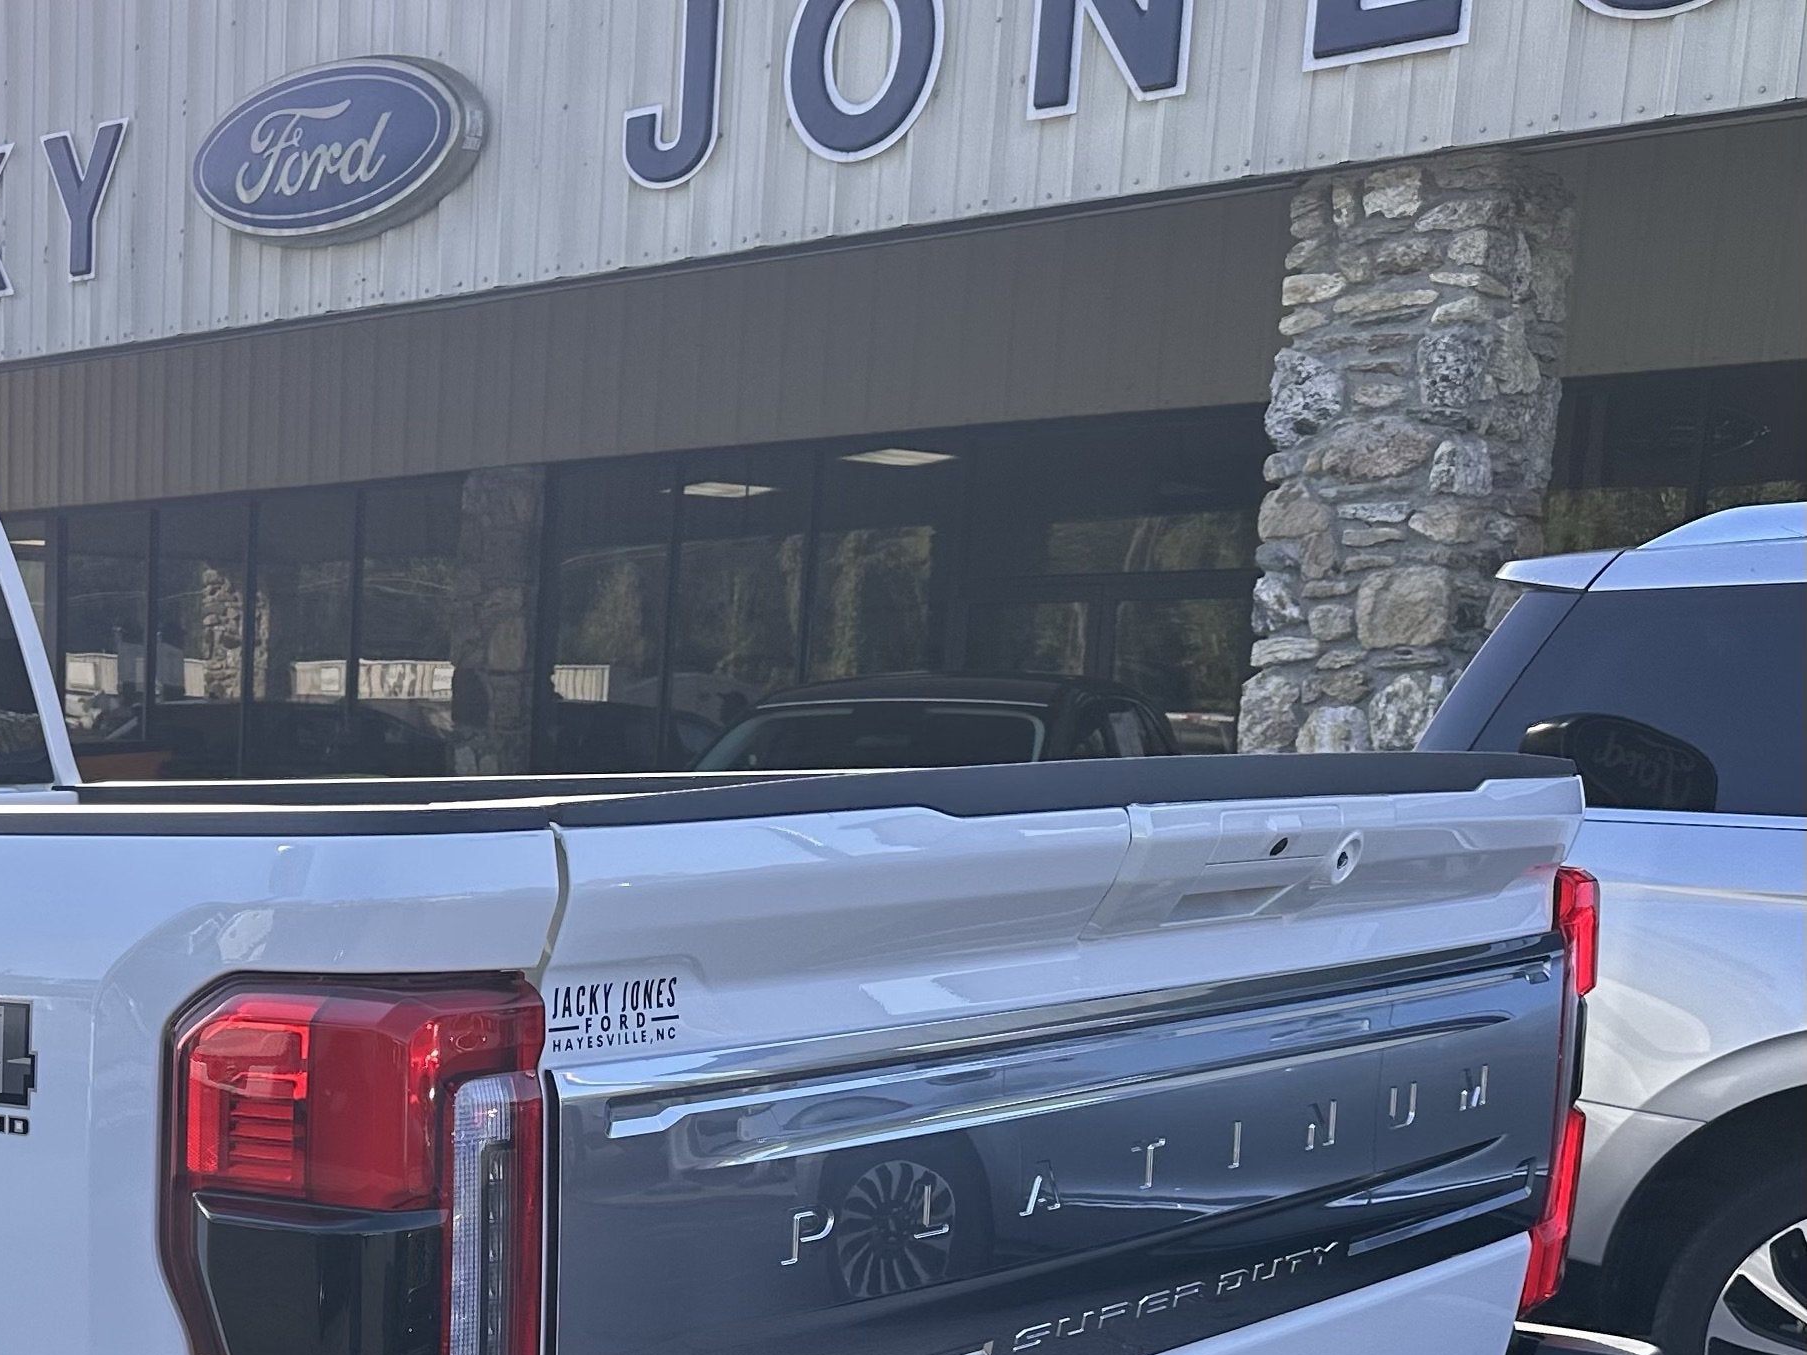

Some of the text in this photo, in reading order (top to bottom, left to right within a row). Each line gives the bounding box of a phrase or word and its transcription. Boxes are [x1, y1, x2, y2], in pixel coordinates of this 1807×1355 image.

[235, 98, 392, 205] Ford
[552, 976, 678, 1019] JACKY JONES
[585, 1013, 646, 1033] FORD
[780, 1062, 1490, 1265] PLATINUM
[1012, 1240, 1338, 1352] SUPER DUTY
